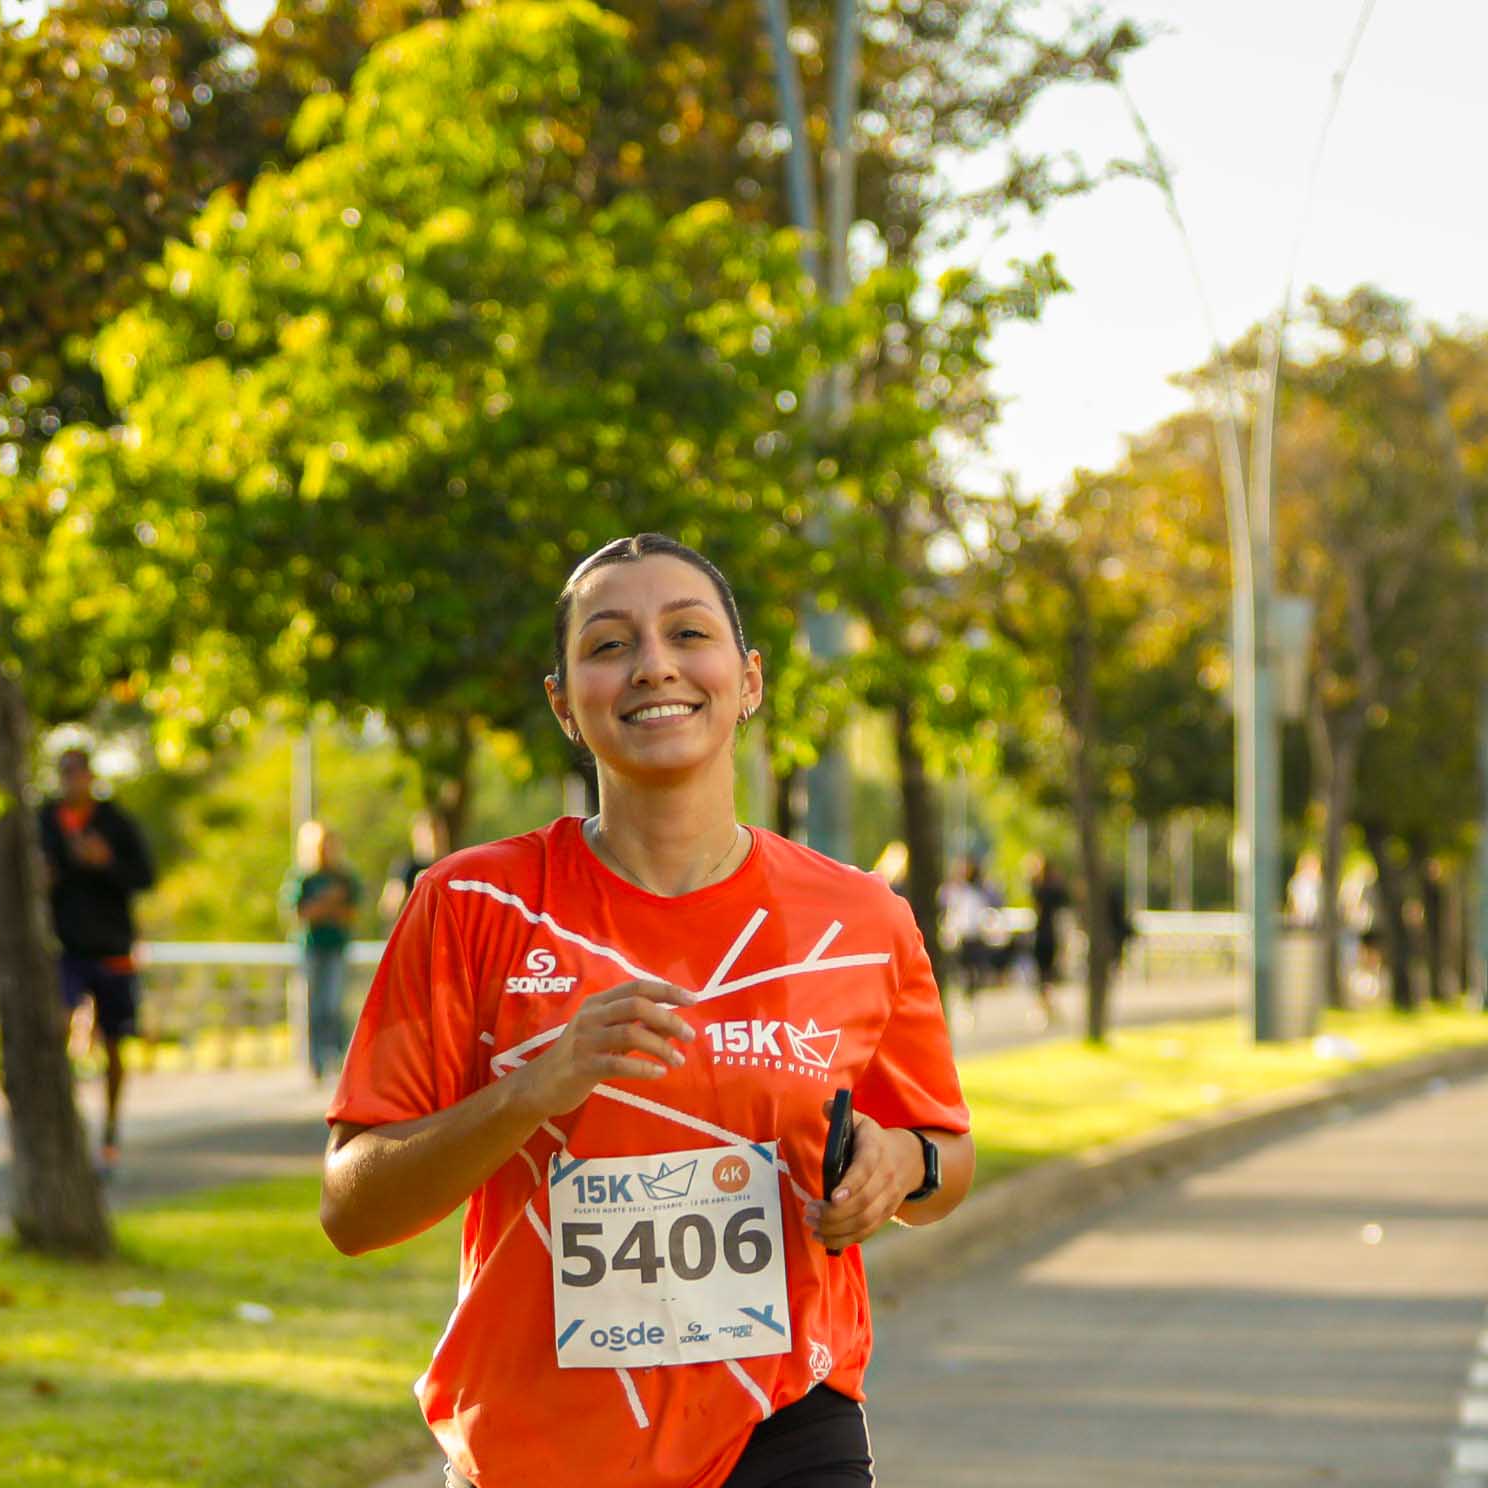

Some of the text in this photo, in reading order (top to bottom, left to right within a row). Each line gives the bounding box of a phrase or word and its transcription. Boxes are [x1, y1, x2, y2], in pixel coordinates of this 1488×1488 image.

[704, 1019, 782, 1056] 15K
[713, 1056, 828, 1083] PUERTO NORTE
[572, 1166, 745, 1205] 15K 4K
[561, 1206, 773, 1288] 5406
[590, 1321, 665, 1350] osde
